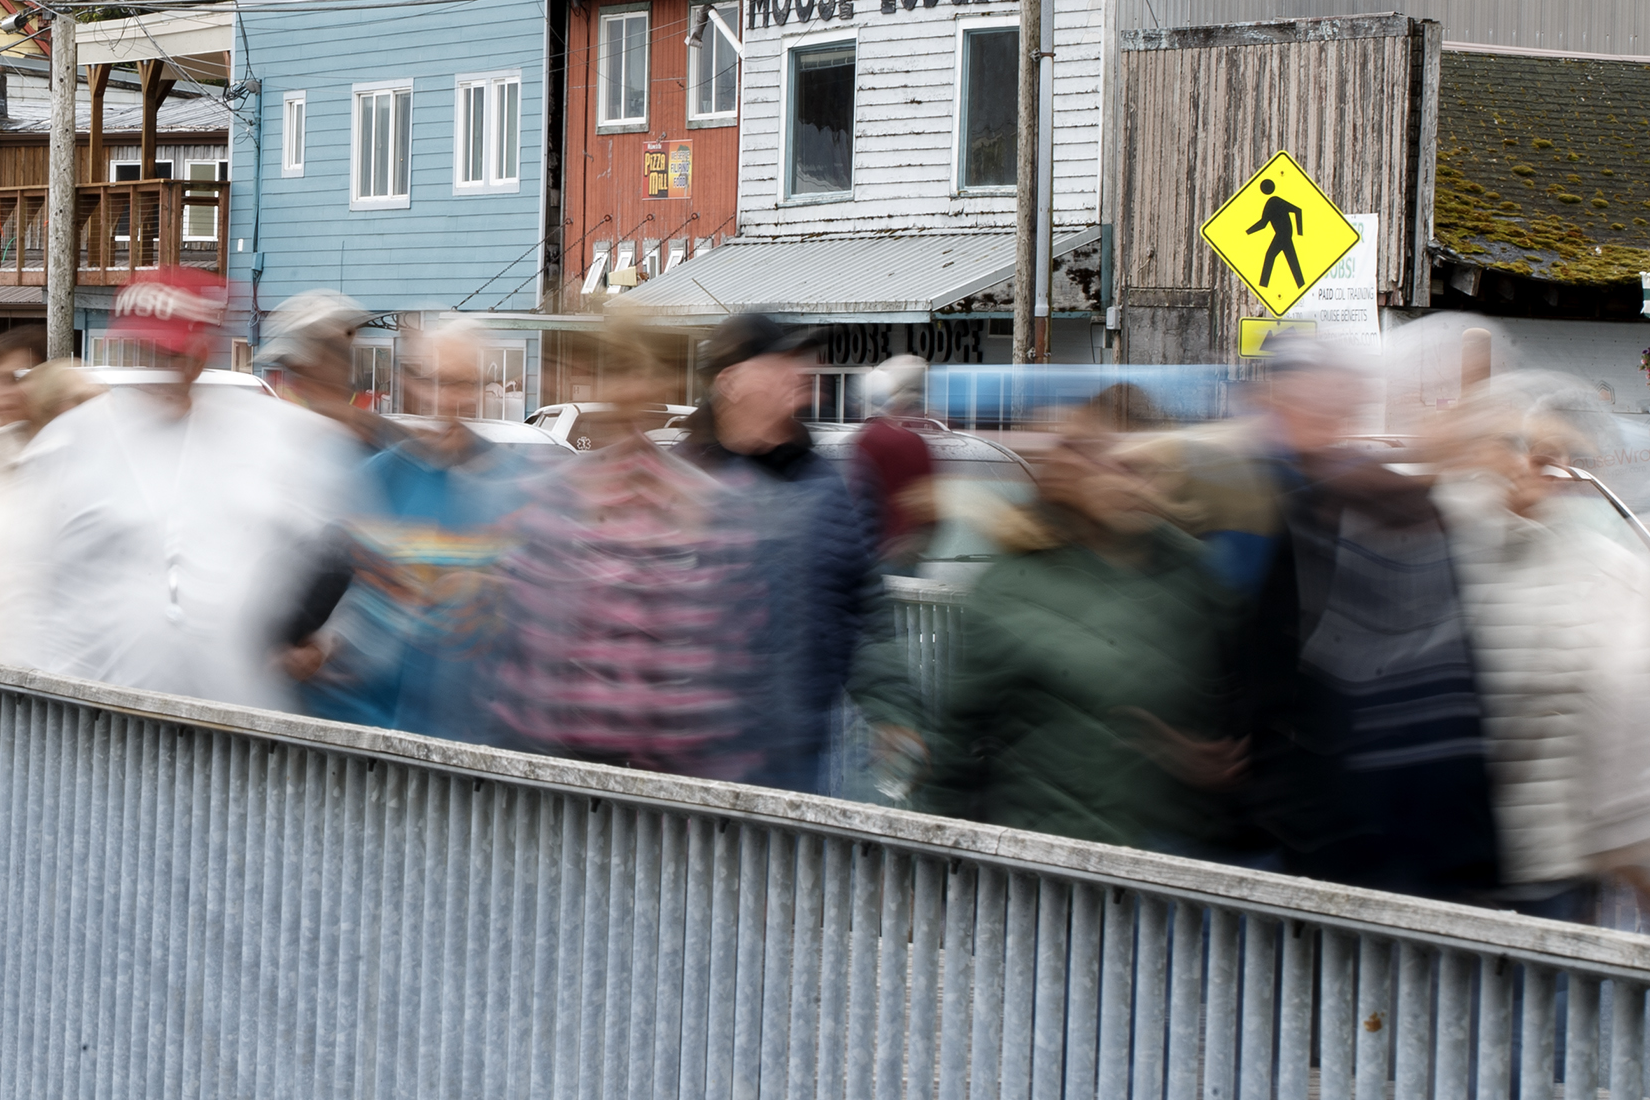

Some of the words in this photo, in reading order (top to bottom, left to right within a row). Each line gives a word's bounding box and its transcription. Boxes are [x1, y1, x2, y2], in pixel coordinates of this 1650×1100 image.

[1318, 288, 1333, 301] PAID
[1347, 287, 1375, 300] TRAINING
[1320, 309, 1340, 322] CRUISE
[1341, 309, 1368, 322] BENEFITS
